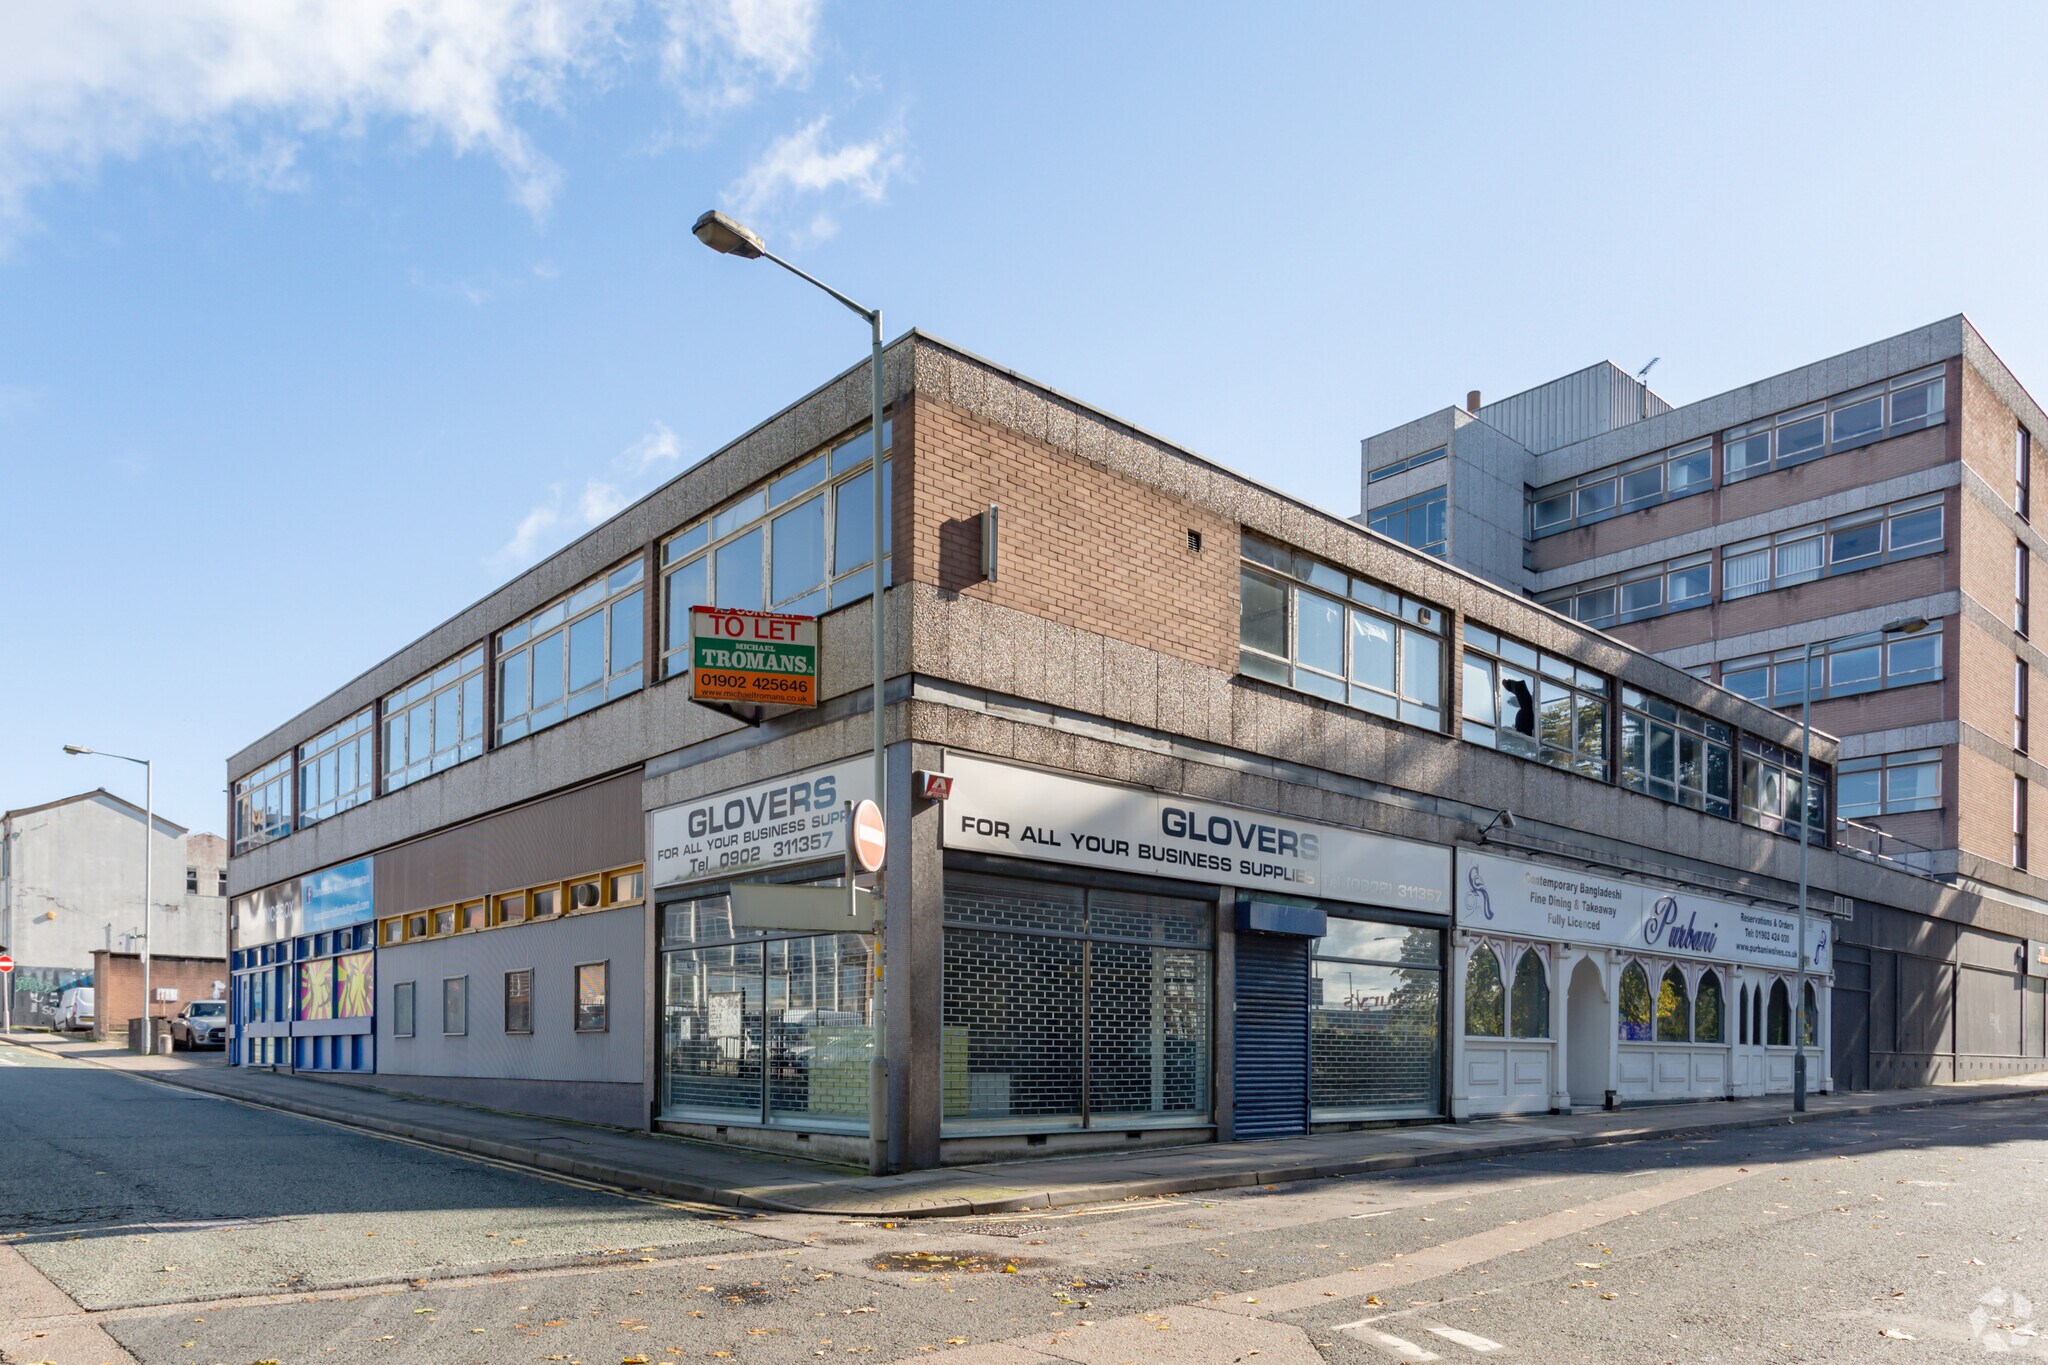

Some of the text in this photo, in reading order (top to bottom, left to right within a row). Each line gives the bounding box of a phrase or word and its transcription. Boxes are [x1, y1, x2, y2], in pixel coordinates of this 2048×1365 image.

[709, 614, 801, 641] TO LET
[702, 648, 807, 673] TROMANS
[735, 643, 776, 652] MICHAEL
[701, 674, 808, 693] 01902 425646
[688, 775, 837, 838] GLOVERS
[657, 847, 679, 861] FOR
[683, 842, 703, 855] ALL
[706, 834, 738, 850] YOUR
[743, 818, 806, 844] BUSINESS
[1161, 806, 1319, 862] GLOVERS
[690, 830, 833, 873] Tel 0902 311357
[961, 815, 1315, 885] FOR ALL YOUR BUSINESS SUPPLIES
[1398, 884, 1443, 903] 311357
[1525, 872, 1622, 900] Contemporary Bangladeshi
[1530, 892, 1617, 919] Fine Dining & Takeaway
[1547, 913, 1600, 931] Fully Licenced
[1644, 895, 1719, 955] Purbani
[1740, 912, 1795, 931] Reservations & Orders
[1754, 929, 1771, 941] 01902
